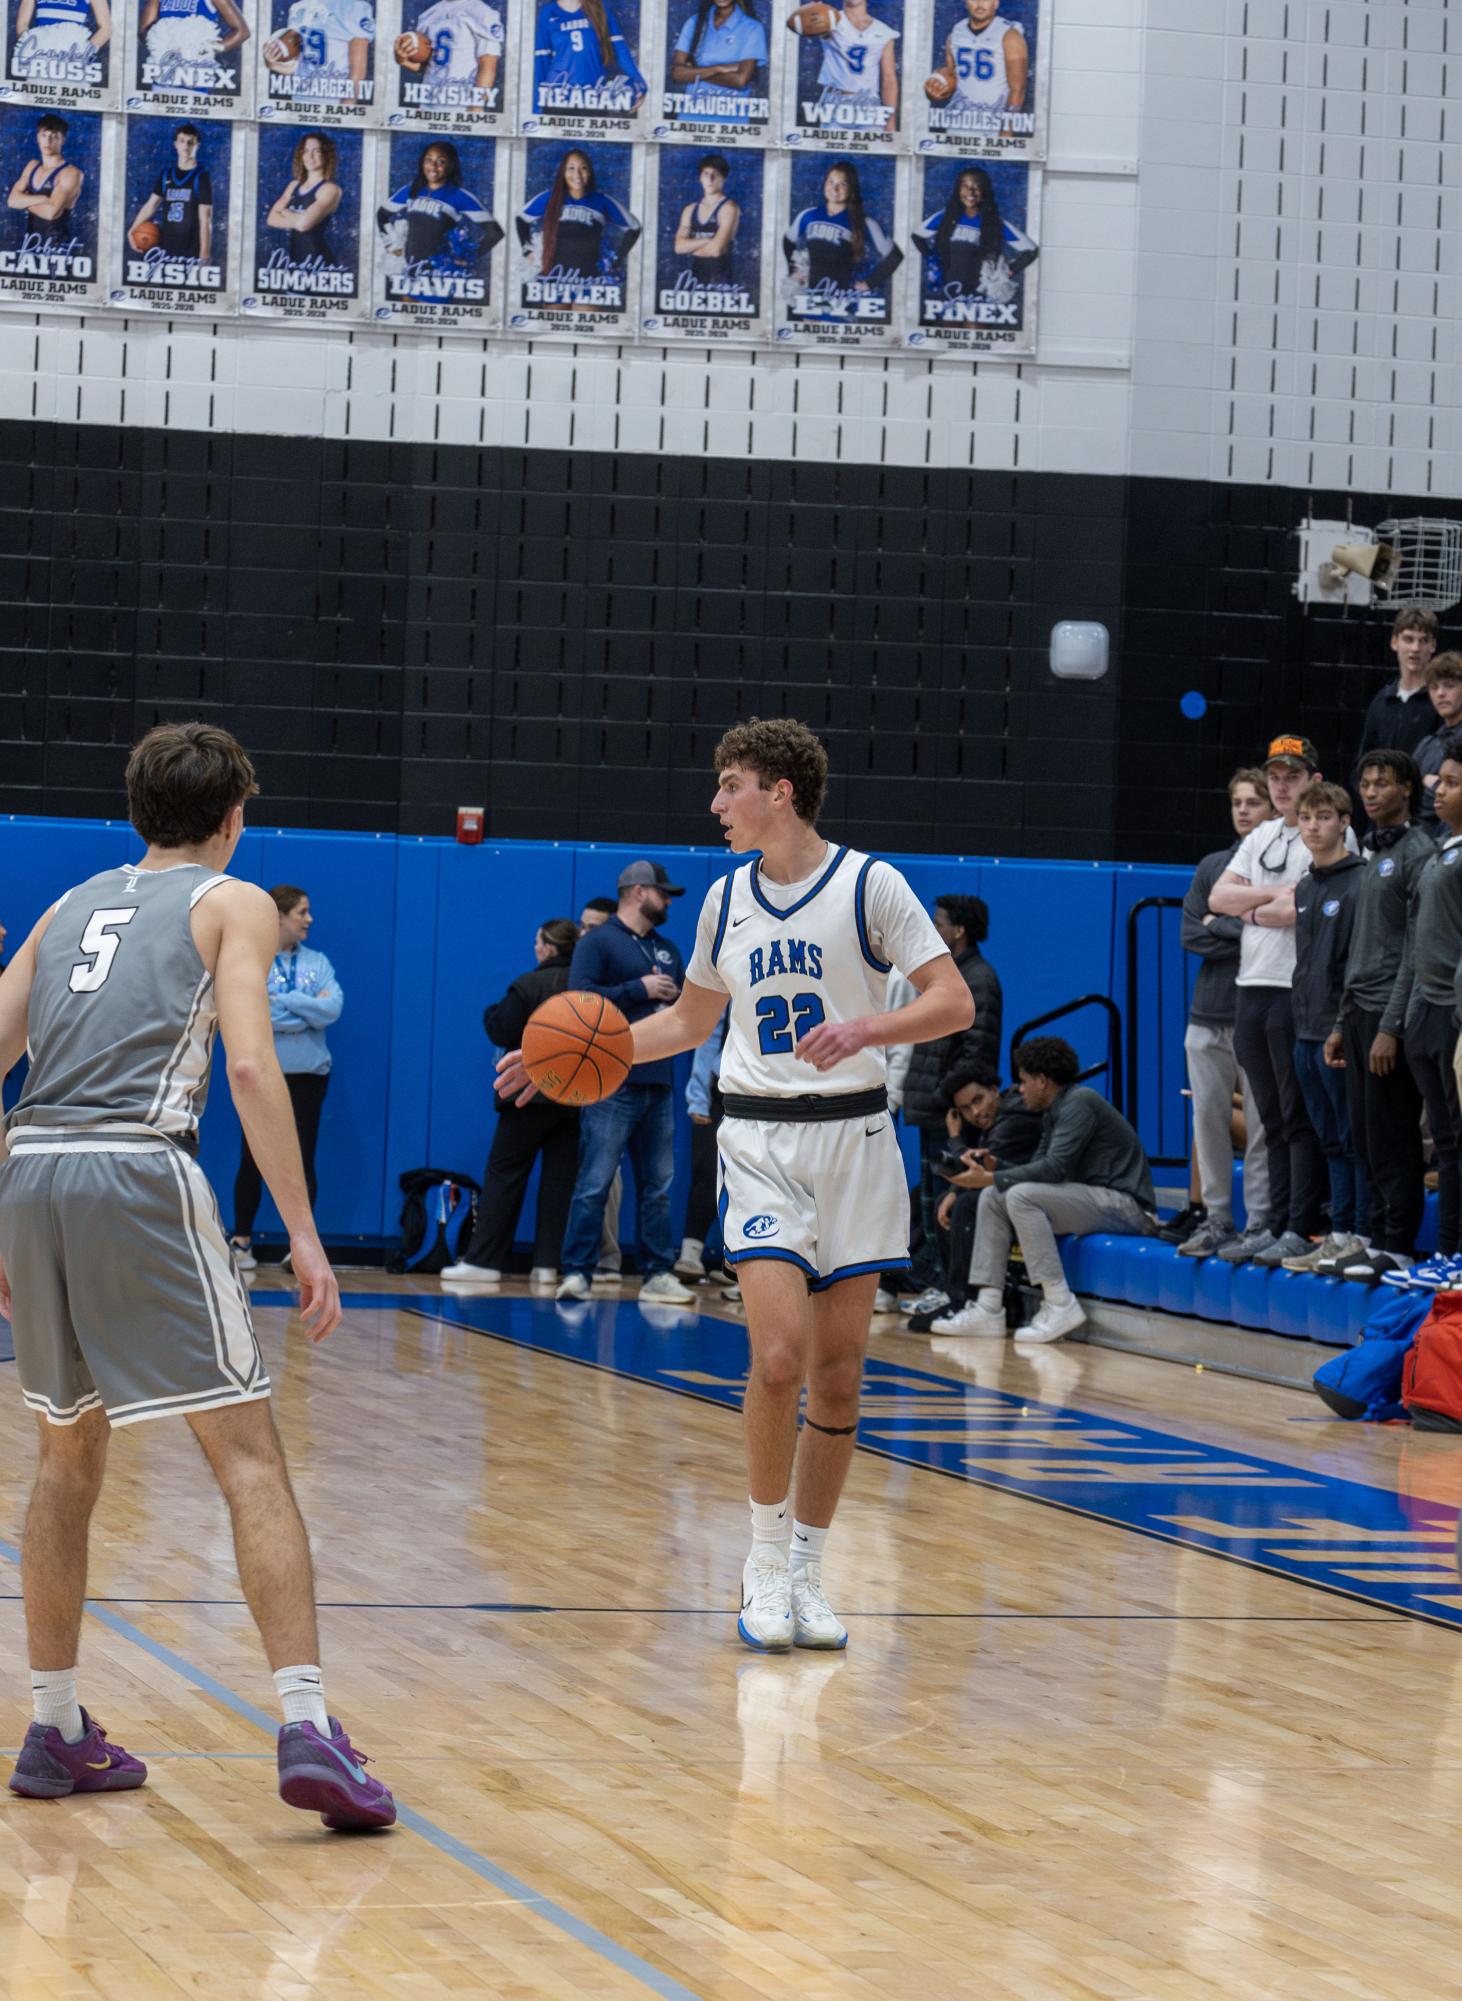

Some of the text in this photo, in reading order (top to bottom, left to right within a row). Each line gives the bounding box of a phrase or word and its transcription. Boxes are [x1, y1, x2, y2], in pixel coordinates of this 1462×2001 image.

[571, 31, 584, 52] 9
[955, 47, 994, 81] 56
[13, 82, 101, 99] LADUE RAMS
[143, 93, 234, 107] LADUE RAMS
[358, 80, 374, 100] IV
[404, 83, 499, 107] HENSLEY
[538, 86, 633, 111] REAGAN
[276, 102, 366, 116] LADUE RAMS
[664, 93, 769, 117] STRAUGHTER
[802, 101, 895, 126] WOLF
[405, 110, 496, 124] LADUE RAMS
[540, 116, 630, 129] LADUE RAMS
[670, 122, 761, 135] LADUE RAMS
[802, 129, 893, 143] LADUE RAMS
[935, 135, 1026, 149] LADUE RAMS
[0, 251, 92, 278] CAITO
[127, 261, 221, 287] BISIG
[1, 278, 87, 294] LADUE RAMS
[258, 267, 354, 294] SUMMERS
[390, 274, 485, 299] DAVIS
[130, 289, 216, 304] LADUE RAMS
[262, 296, 348, 310] LADUE RAMS
[526, 282, 621, 306] BUTLER
[659, 289, 755, 314] GOEBEL
[392, 303, 482, 317] LADUE RAMS
[528, 312, 619, 325] LADUE RAMS
[924, 299, 1018, 323] PINEX
[663, 317, 750, 330] LADUE RAMS
[794, 323, 885, 336] LADUE RAMS
[925, 328, 1016, 342] LADUE RAMS
[68, 906, 140, 994] 5
[749, 938, 823, 987] RAMS
[755, 992, 826, 1056] 22
